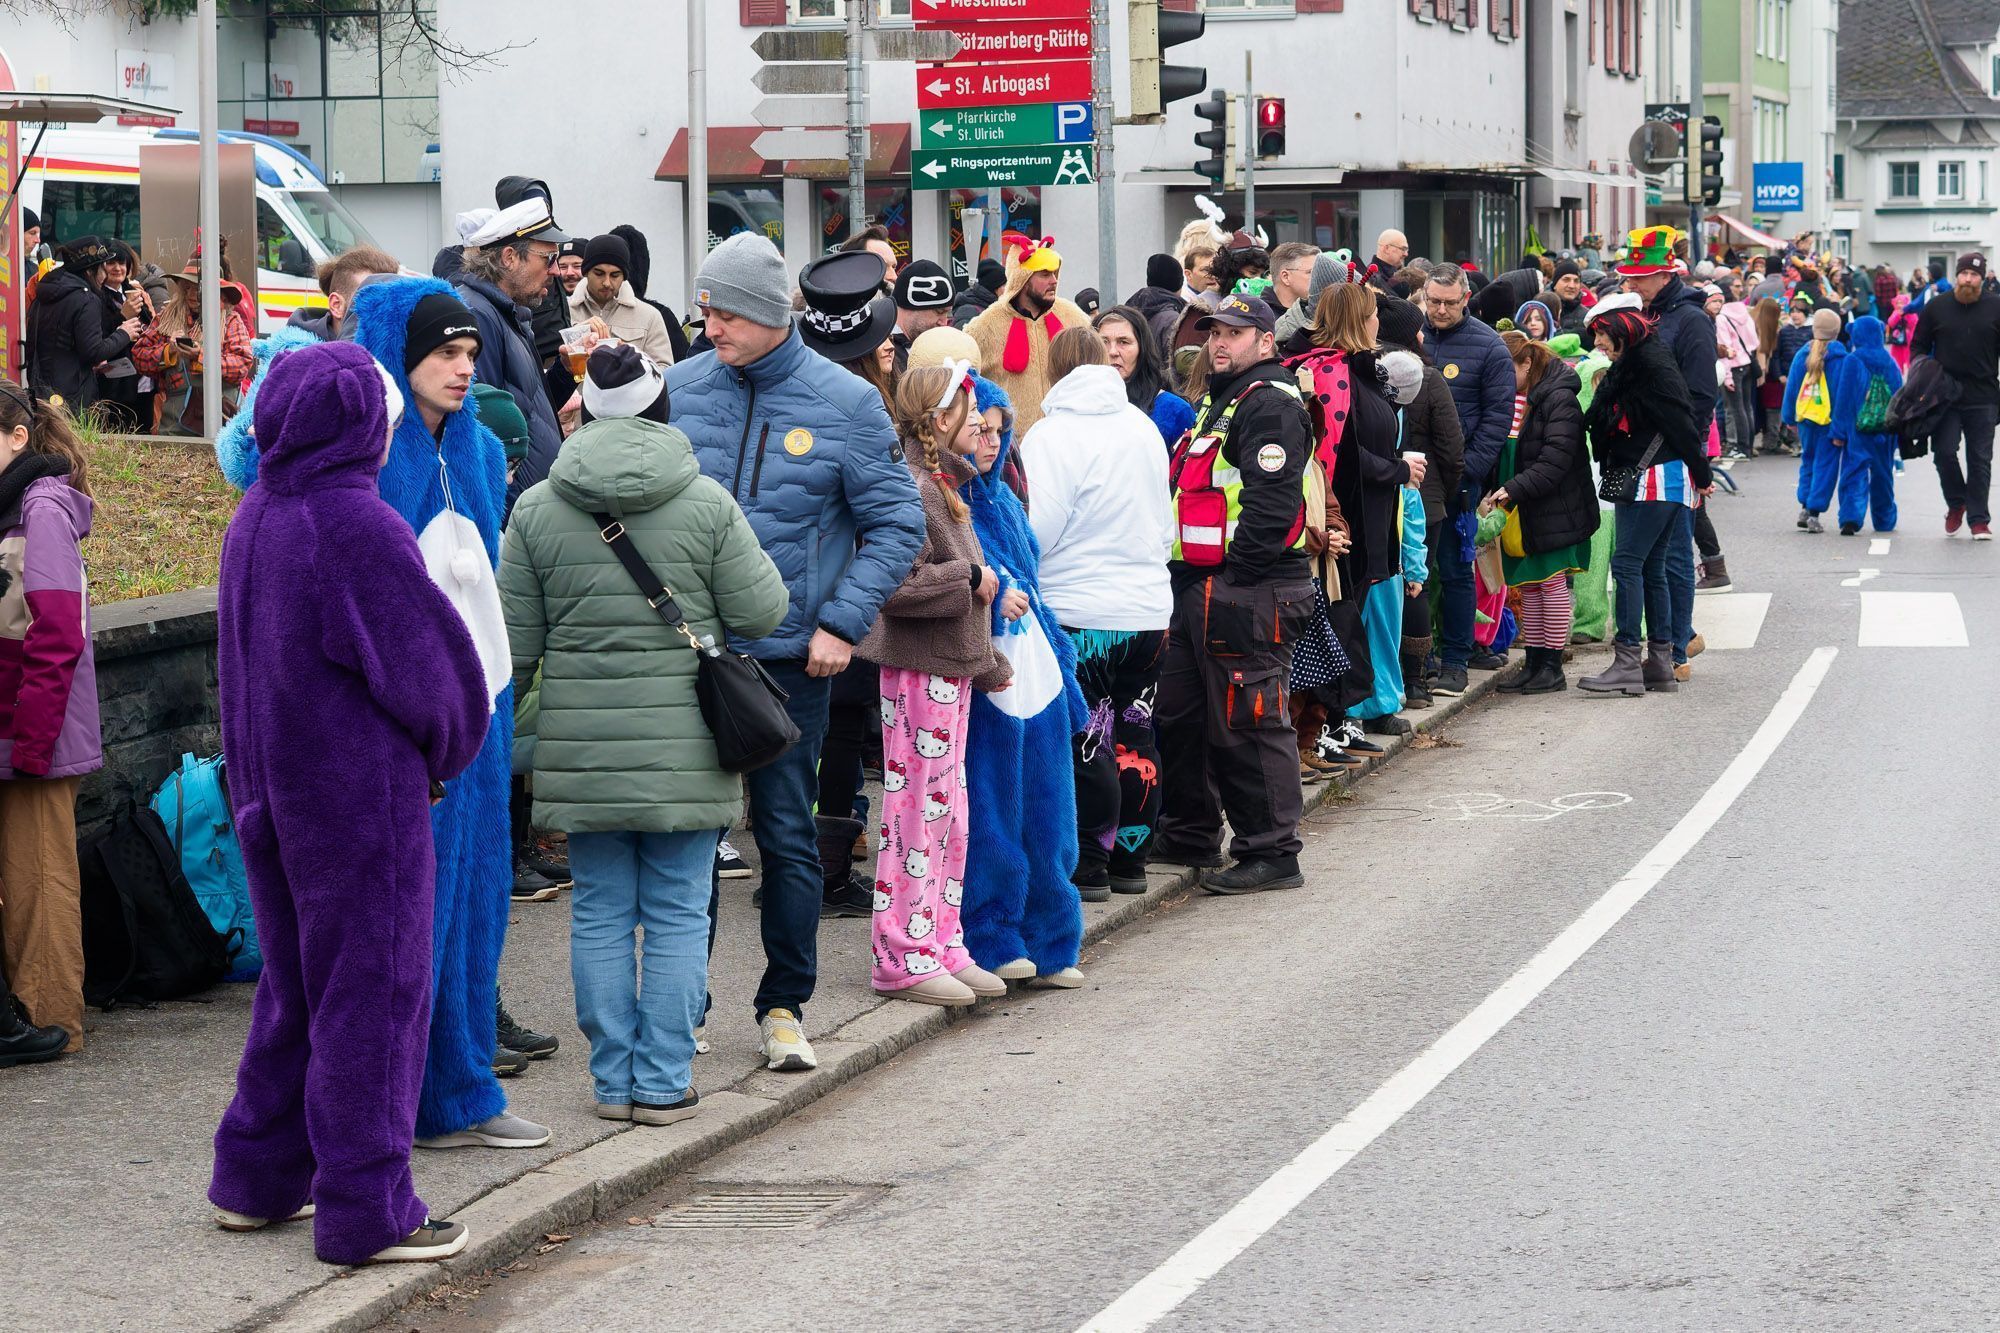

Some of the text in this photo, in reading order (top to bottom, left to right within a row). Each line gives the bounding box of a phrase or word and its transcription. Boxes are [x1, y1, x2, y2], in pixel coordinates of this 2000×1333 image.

[125, 62, 146, 88] graf
[955, 73, 1051, 96] St. Arbogast
[957, 111, 1017, 125] Pfarrkirche
[1057, 104, 1087, 141] P
[957, 127, 1005, 141] St. Ulrich
[950, 156, 1052, 169] Ringsportzentrum
[987, 171, 1016, 181] West
[1756, 185, 1800, 198] HYPO
[1232, 300, 1250, 313] PD
[898, 692, 912, 738] Hello Kitty
[895, 836, 903, 858] Hello
[879, 933, 901, 969] Hello Kitty
